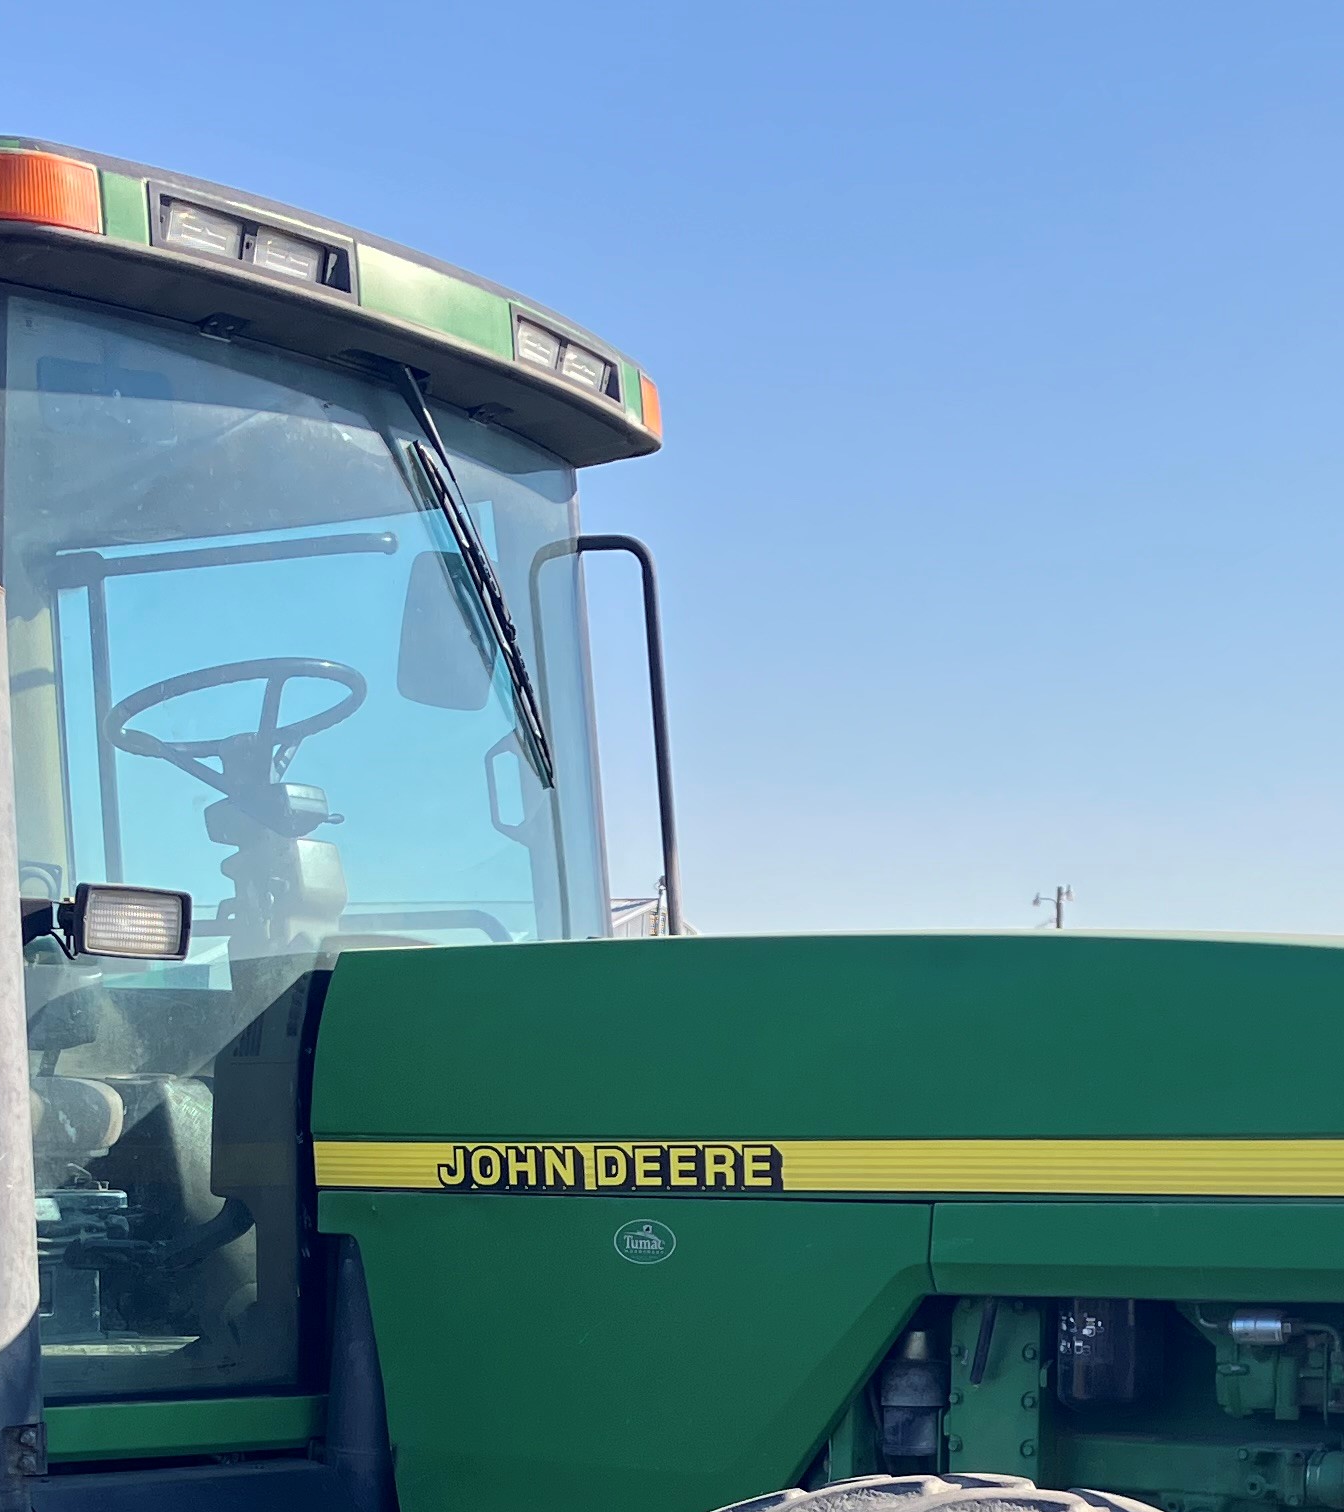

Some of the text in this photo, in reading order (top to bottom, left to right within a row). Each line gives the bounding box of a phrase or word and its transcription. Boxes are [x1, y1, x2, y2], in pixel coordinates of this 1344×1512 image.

[437, 1145, 780, 1190] JOHN DEERE
[623, 1234, 665, 1250] Tumac
